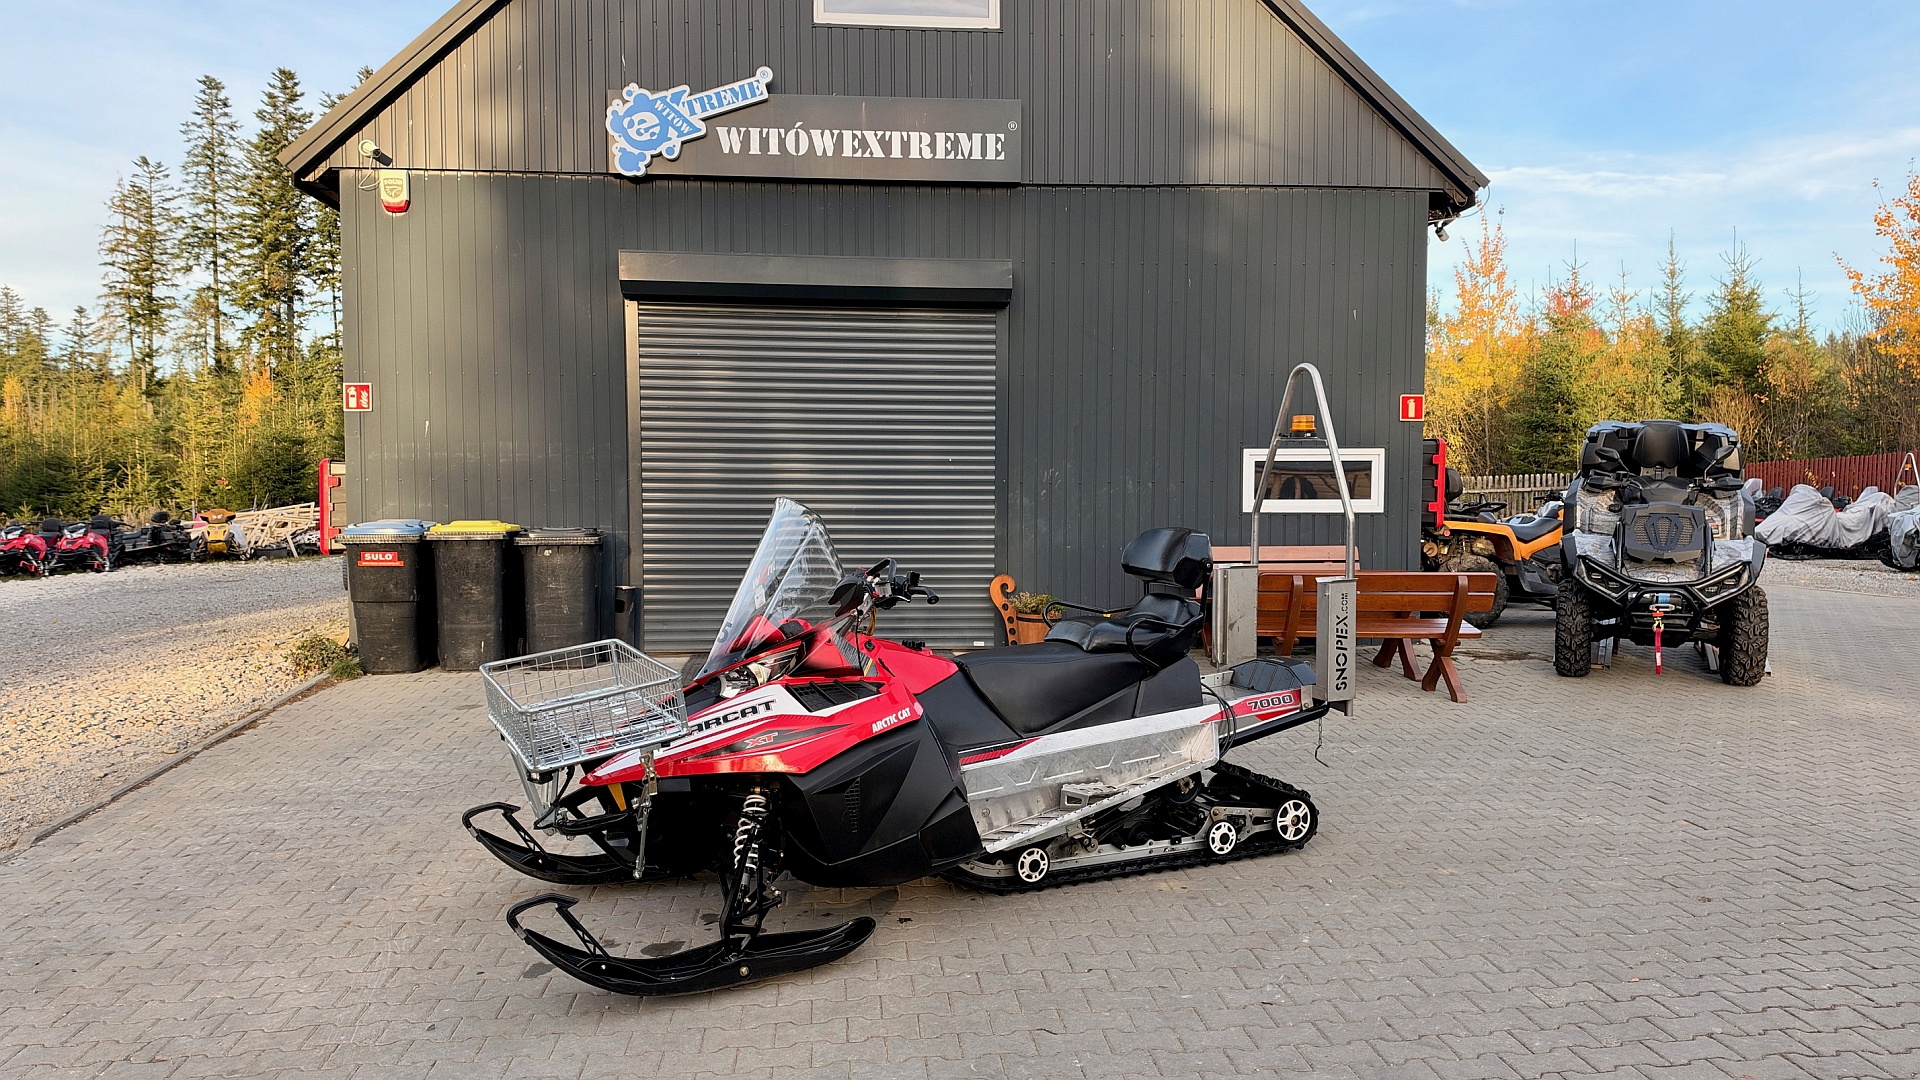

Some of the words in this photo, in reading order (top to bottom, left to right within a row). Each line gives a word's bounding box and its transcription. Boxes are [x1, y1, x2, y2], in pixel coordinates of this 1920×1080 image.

[654, 99, 692, 134] WITÓW
[364, 553, 393, 561] SULO
[1248, 694, 1294, 711] 7000
[687, 699, 777, 736] ARCAT
[872, 713, 898, 733] ARCTIC
[897, 707, 911, 720] CAT
[744, 732, 778, 749] XT
